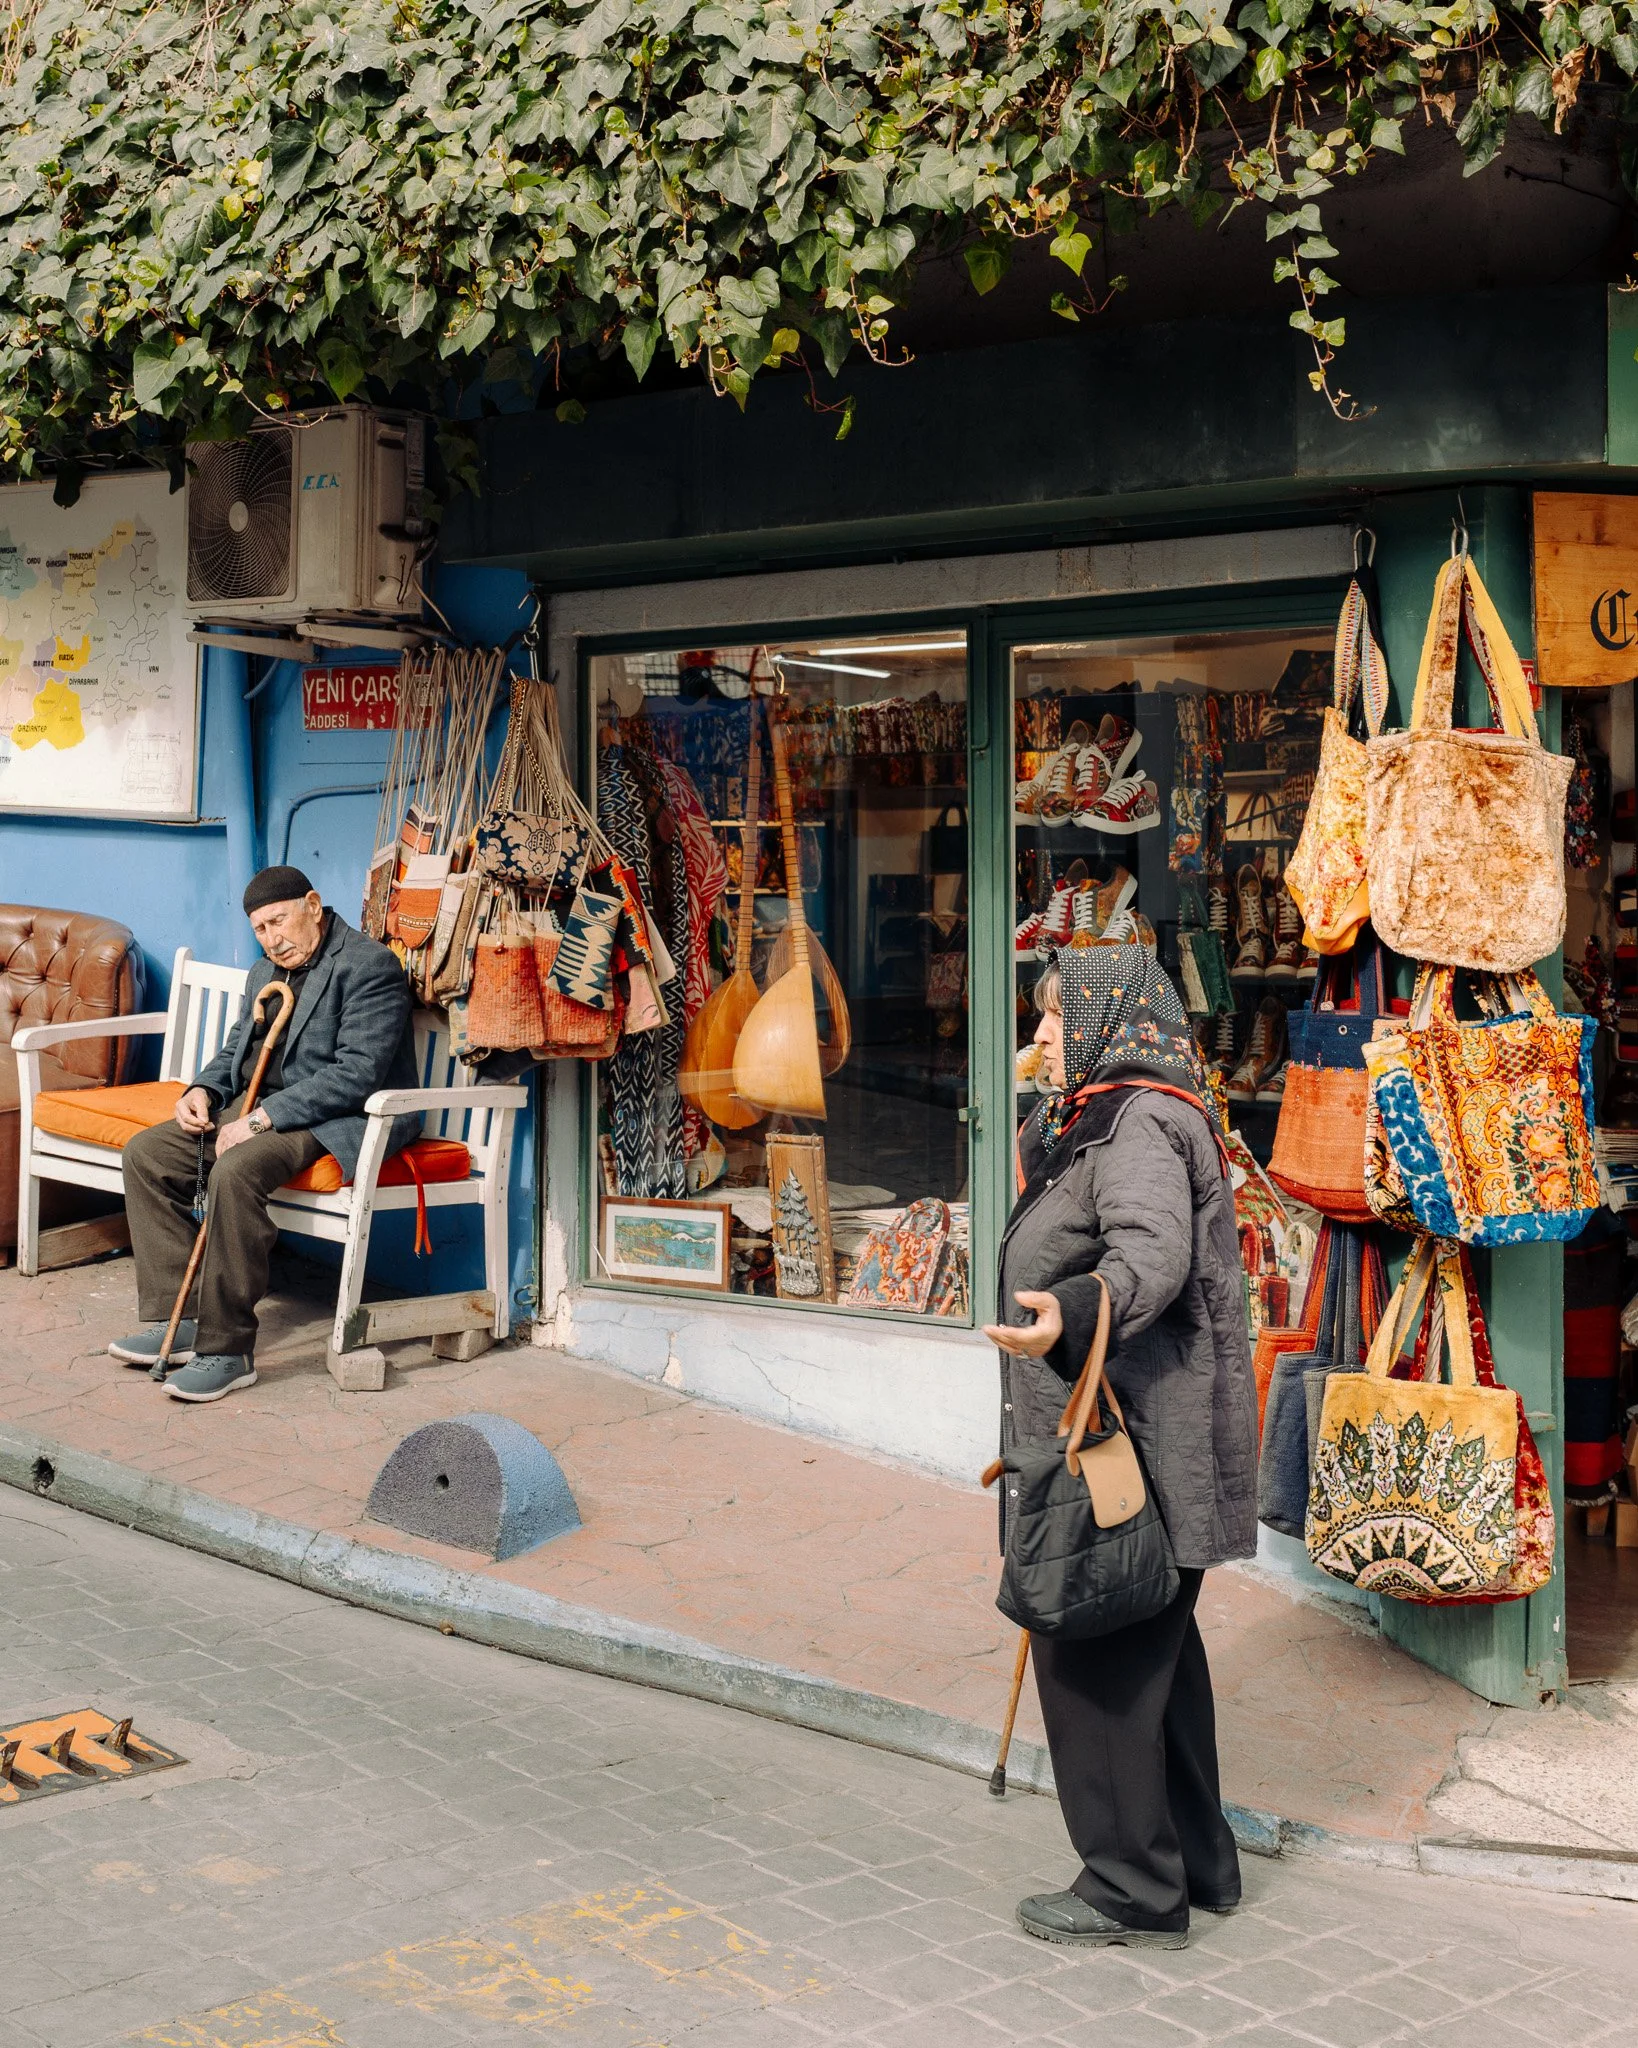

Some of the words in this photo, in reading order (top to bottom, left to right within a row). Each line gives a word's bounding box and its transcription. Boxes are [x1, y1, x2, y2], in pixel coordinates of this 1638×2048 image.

[26, 557, 41, 565] ORDU
[69, 552, 93, 560] TRABZON
[1590, 588, 1638, 651] C
[149, 665, 160, 673] VAN
[304, 671, 345, 704] YENİ
[351, 674, 402, 707] ÇARŞ
[304, 712, 350, 729] CADDESİ
